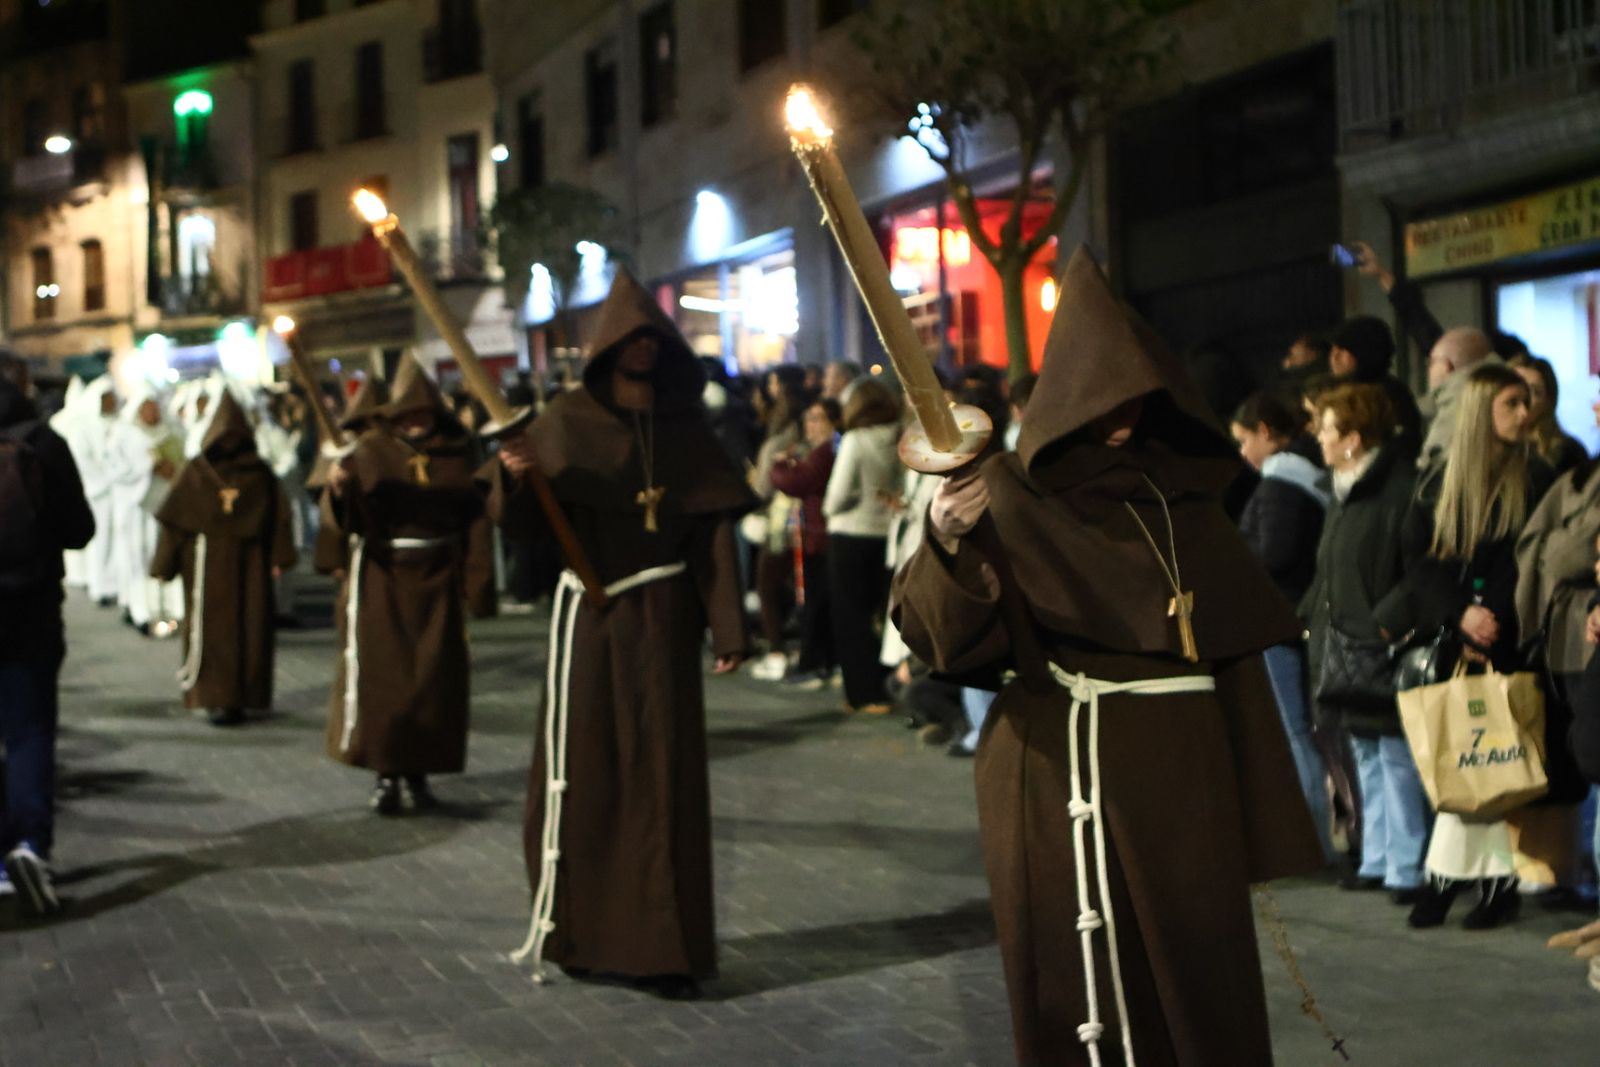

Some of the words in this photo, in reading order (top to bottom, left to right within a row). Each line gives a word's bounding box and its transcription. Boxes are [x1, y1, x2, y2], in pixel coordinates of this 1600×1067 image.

[1412, 203, 1529, 245] RESTAURANTE
[1445, 237, 1494, 264] CHINO
[1472, 728, 1486, 749] 7
